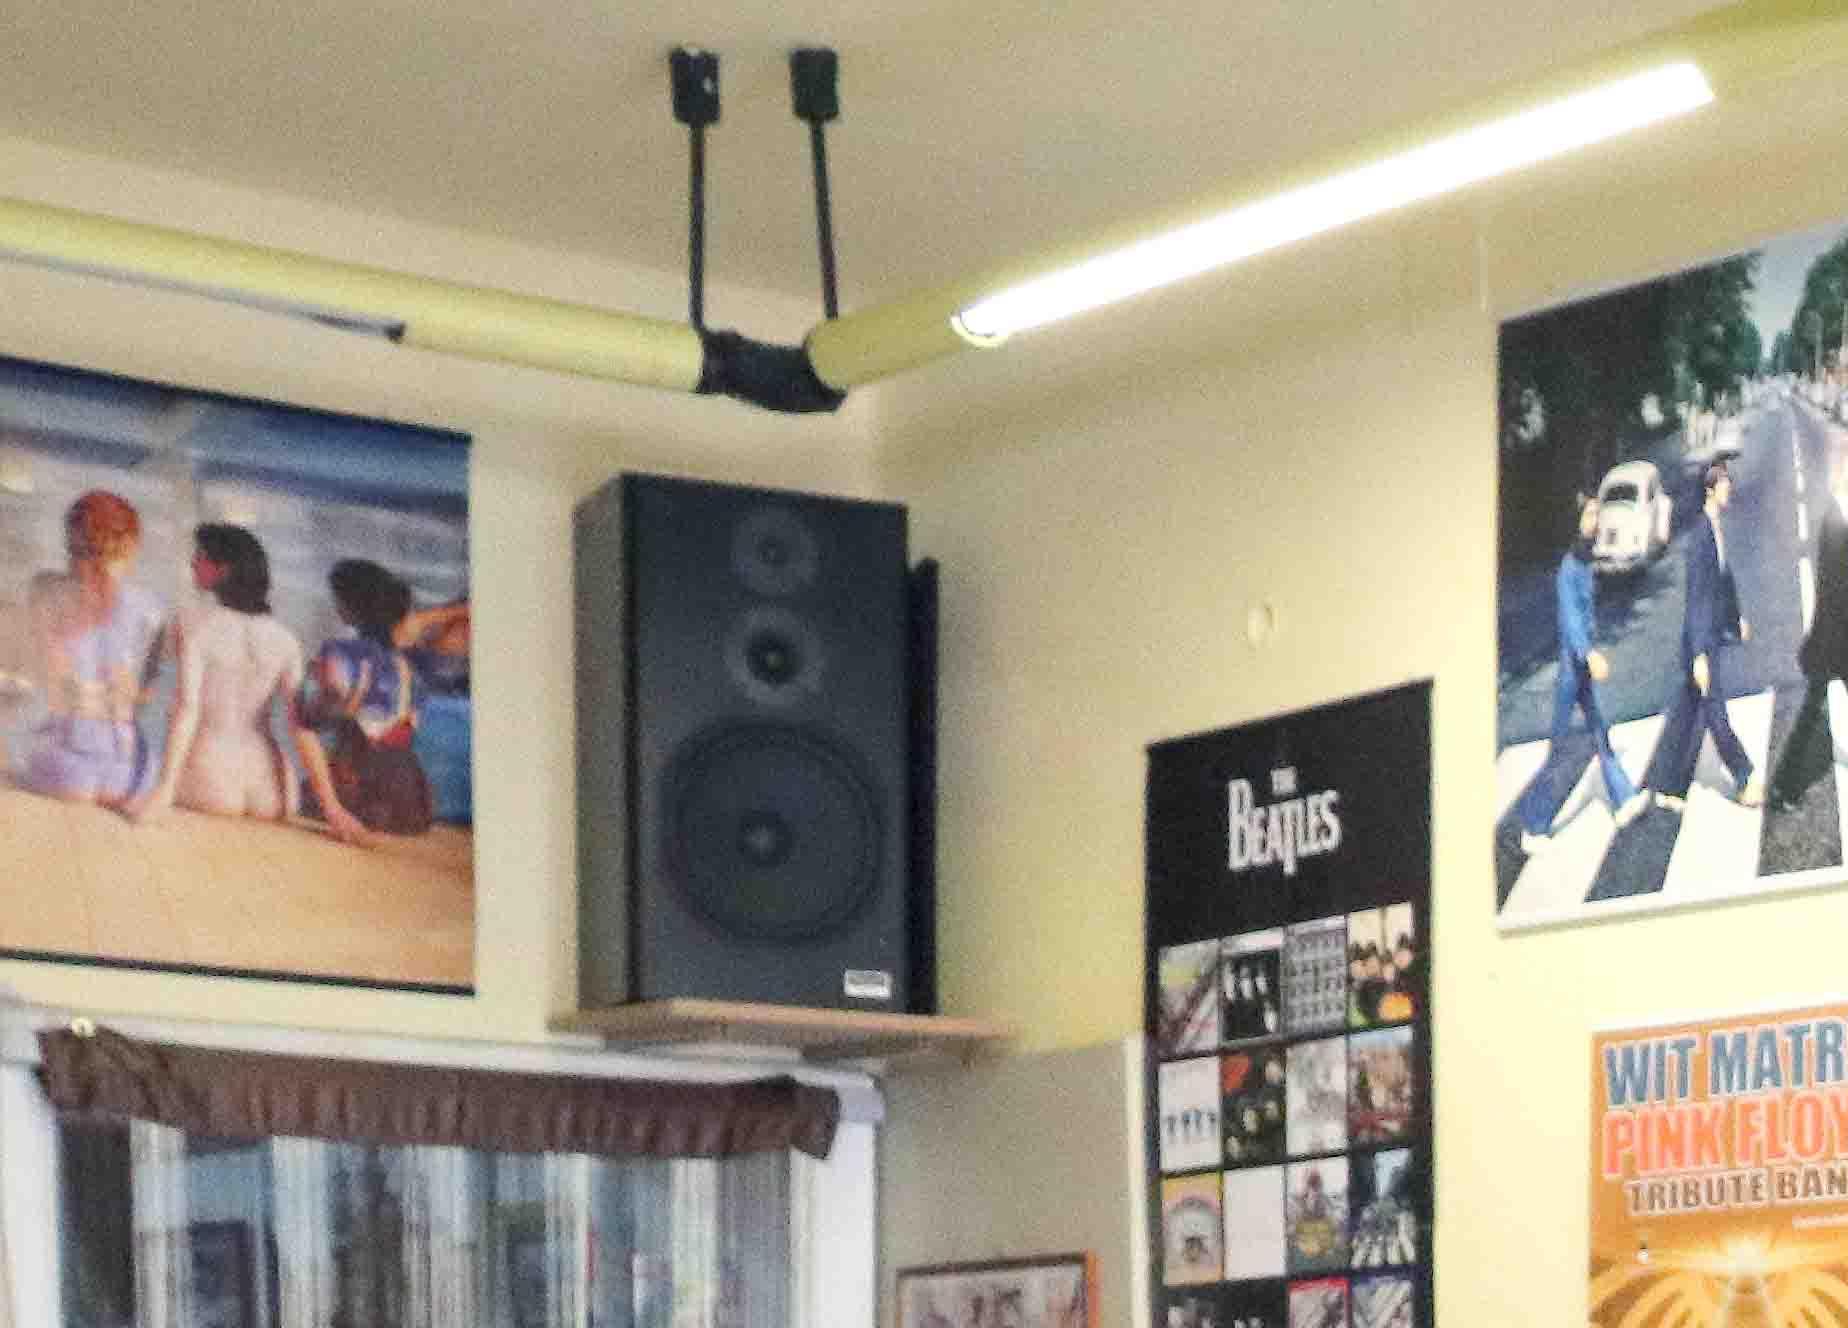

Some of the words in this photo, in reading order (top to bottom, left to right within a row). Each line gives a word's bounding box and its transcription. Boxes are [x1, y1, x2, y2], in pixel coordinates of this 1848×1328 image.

[1228, 779, 1342, 875] BEATLES
[1606, 1040, 1696, 1108] WIT
[1604, 1106, 1724, 1176] PINK
[1628, 1169, 1765, 1216] TRIBUTE
